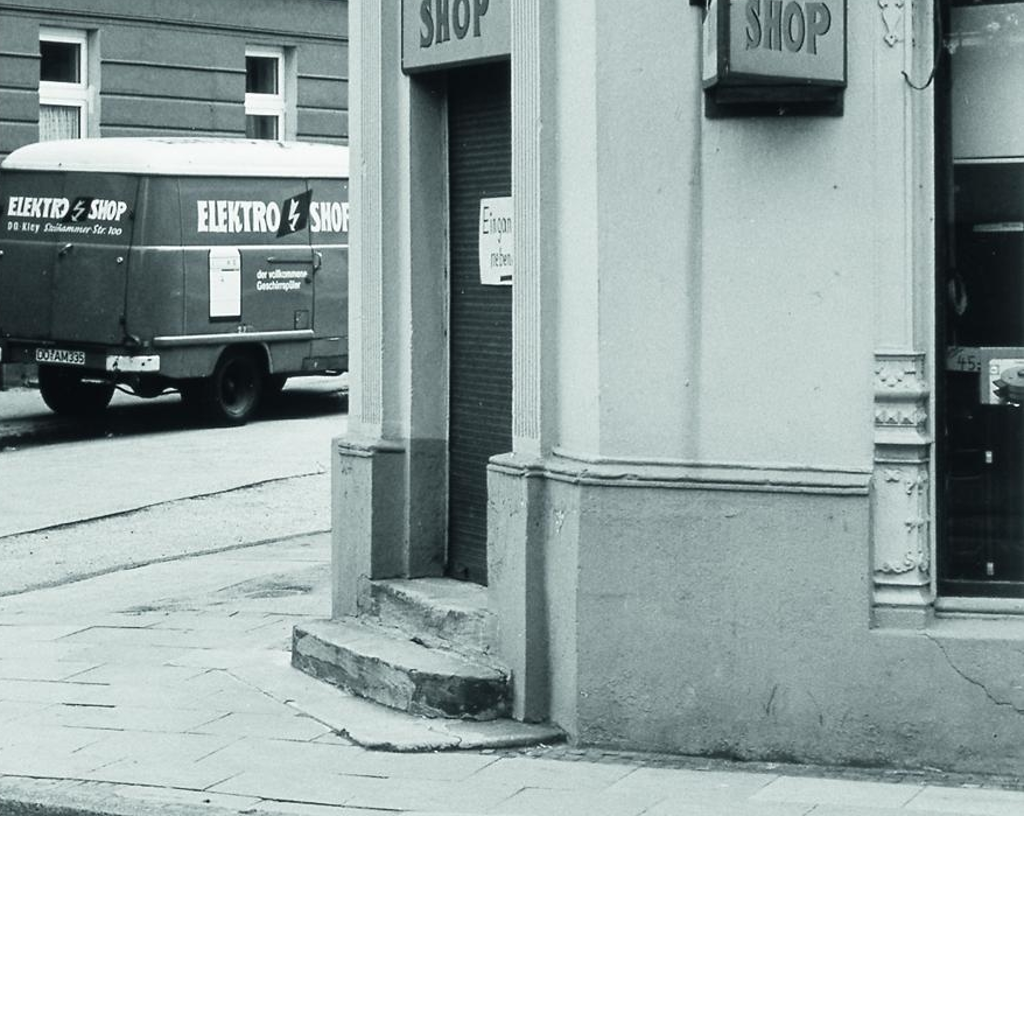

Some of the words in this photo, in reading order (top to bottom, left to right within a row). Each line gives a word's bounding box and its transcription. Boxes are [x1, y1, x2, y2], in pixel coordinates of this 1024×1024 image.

[7, 196, 70, 219] ELEKTRO
[87, 198, 128, 222] SHOP
[197, 199, 281, 233] ELEKTRO
[107, 226, 123, 236] 100
[256, 269, 268, 279] der
